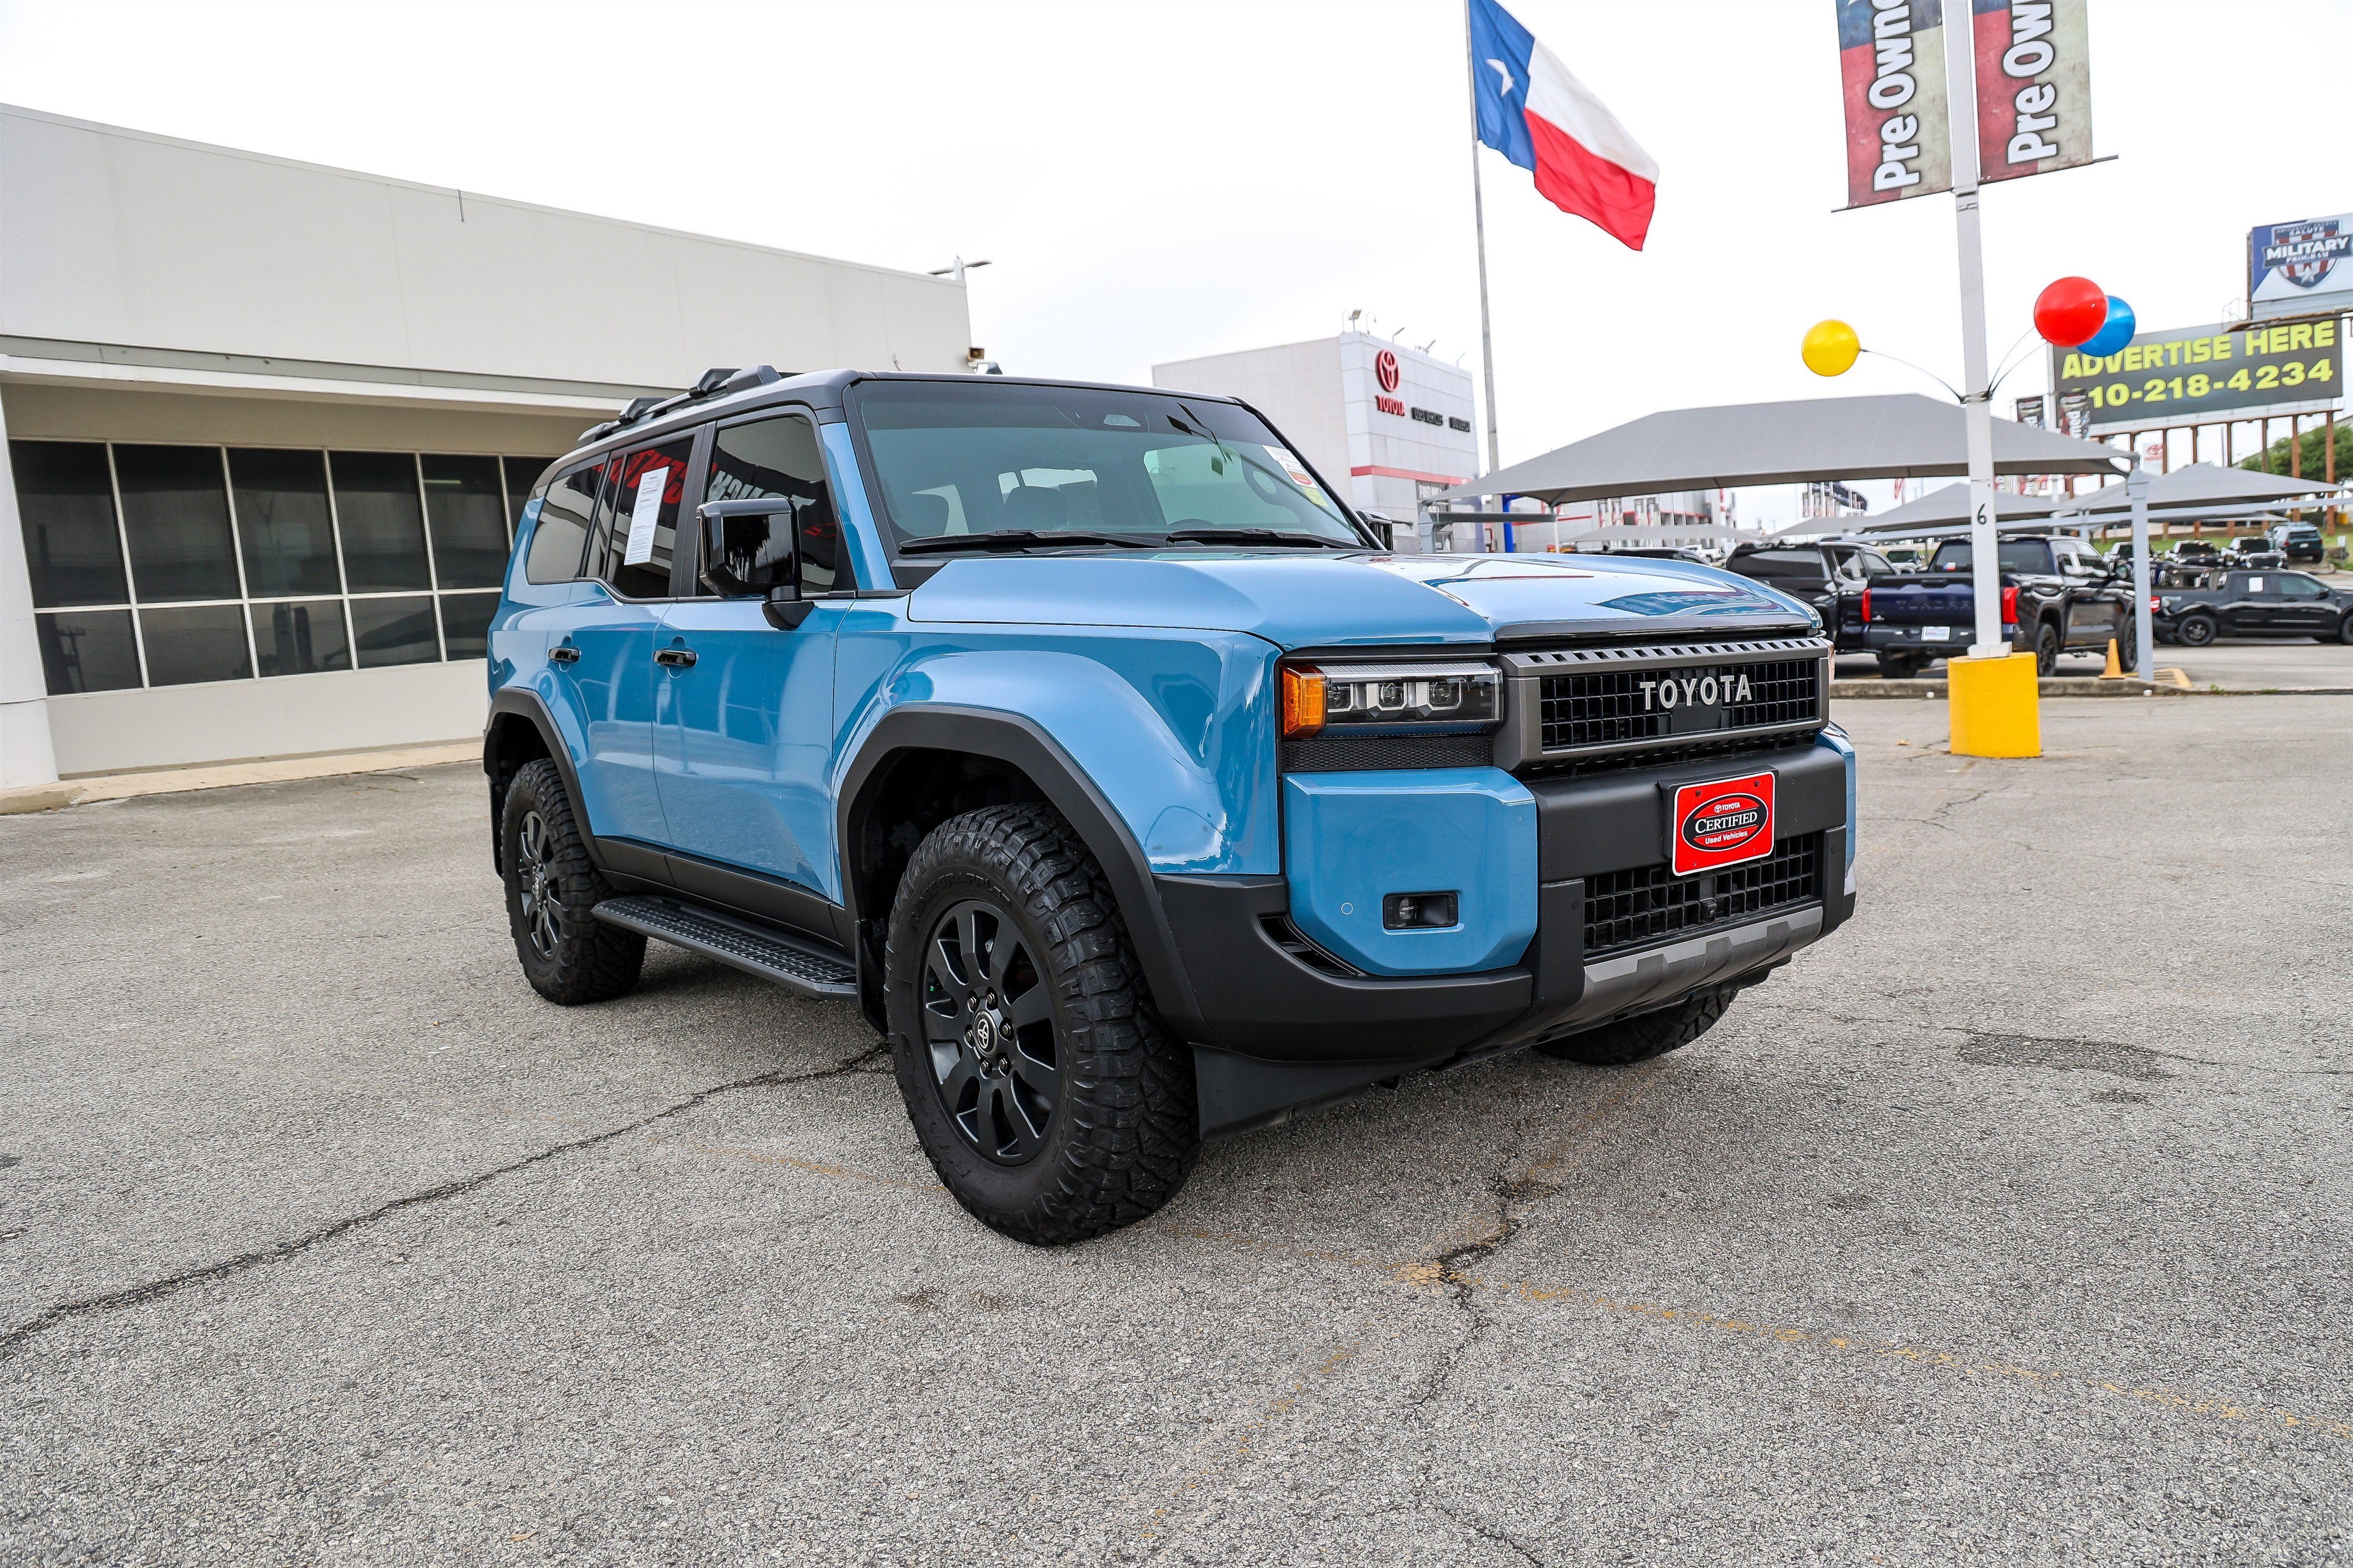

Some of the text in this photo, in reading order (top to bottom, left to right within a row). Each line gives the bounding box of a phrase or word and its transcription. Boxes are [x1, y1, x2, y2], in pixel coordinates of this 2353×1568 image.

[2007, 83, 2057, 164] Pre
[1873, 114, 1919, 191] Pre
[2266, 236, 2350, 261] MILITARY
[2061, 320, 2335, 380] ADVERTISE HERE
[1376, 395, 1406, 416] TOYOTA
[1977, 503, 1986, 524] 6
[1640, 674, 1752, 710] TOYOTA
[1722, 802, 1741, 811] TOYOTA
[1695, 812, 1758, 833] CERTIFIED
[1705, 830, 1748, 844] Used Vehicles
